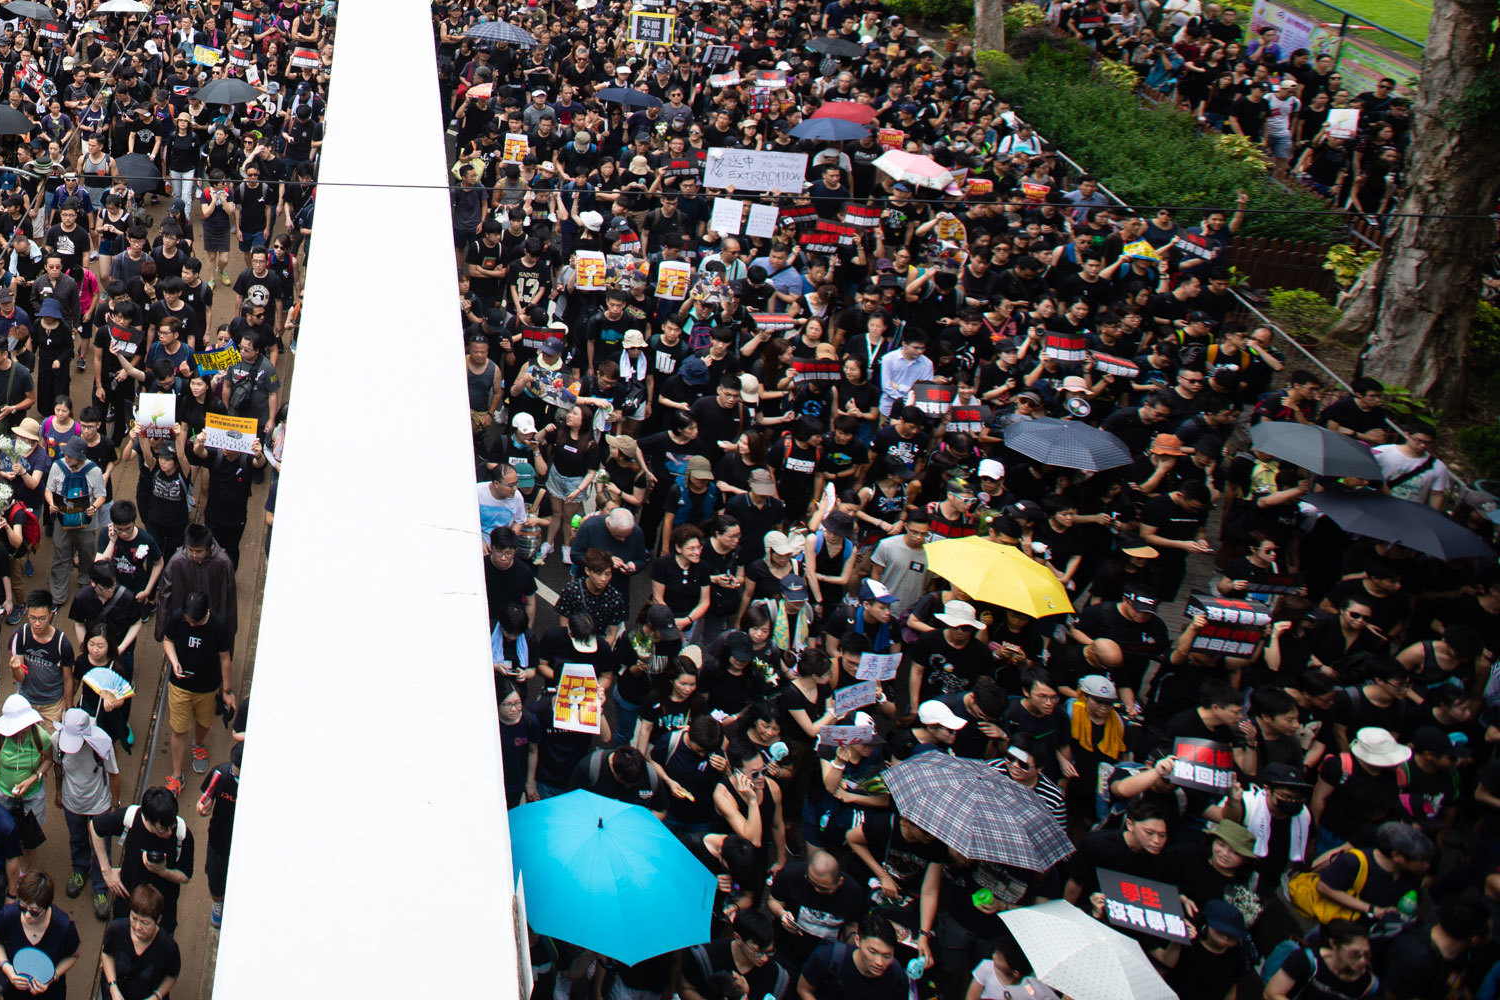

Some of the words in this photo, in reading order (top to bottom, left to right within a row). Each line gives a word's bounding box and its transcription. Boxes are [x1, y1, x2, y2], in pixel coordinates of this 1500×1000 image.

[728, 171, 801, 181] EXTRADITION
[517, 278, 540, 302] 13
[927, 389, 951, 401] 學生
[188, 636, 202, 648] OFF
[560, 674, 570, 686] Do
[571, 678, 582, 689] you
[580, 704, 597, 726] Men
[1171, 758, 1239, 787] 撤回控
[1120, 881, 1162, 908] 學生
[1104, 900, 1188, 939] 沒有暴動
